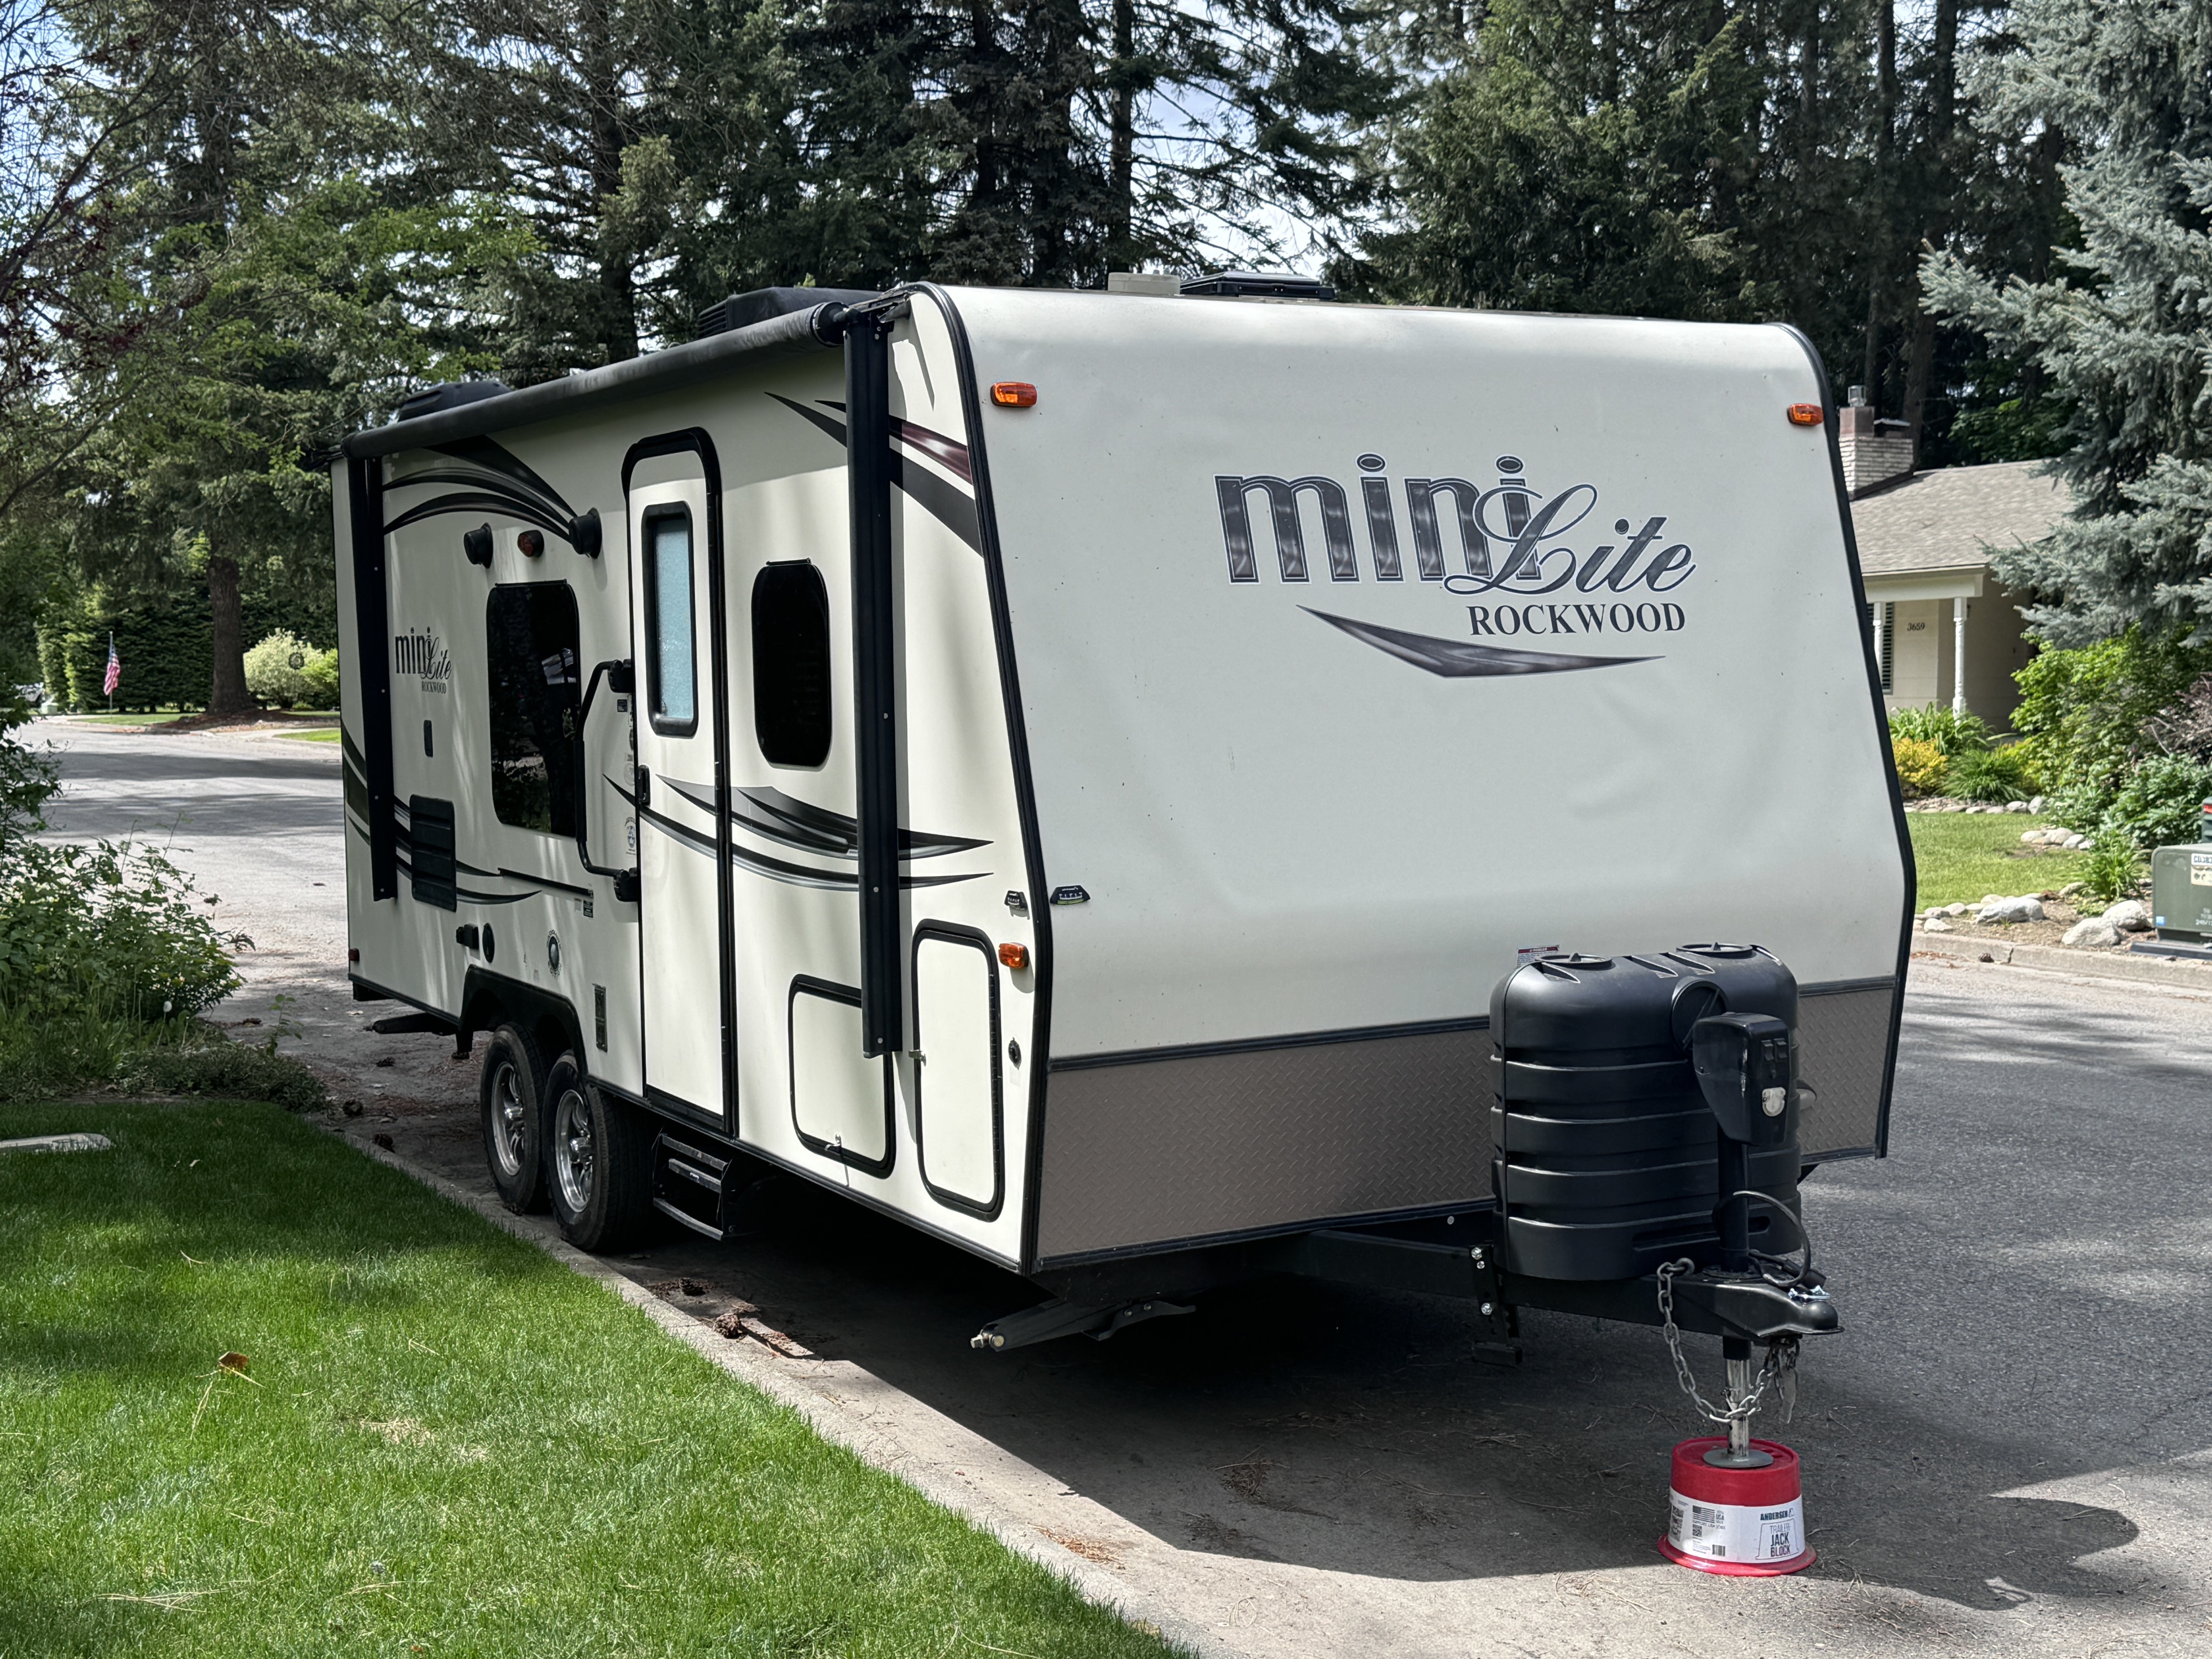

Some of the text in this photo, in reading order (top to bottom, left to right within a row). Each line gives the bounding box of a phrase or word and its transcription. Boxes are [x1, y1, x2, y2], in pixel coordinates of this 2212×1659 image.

[1214, 453, 1697, 595] mini Lite
[1465, 603, 1686, 636] ROCKWOOD
[395, 627, 452, 680] mini Lite
[1770, 1523, 1790, 1533] TRAILER
[1771, 1532, 1790, 1546] JACK
[1771, 1545, 1791, 1557] BLOCK
